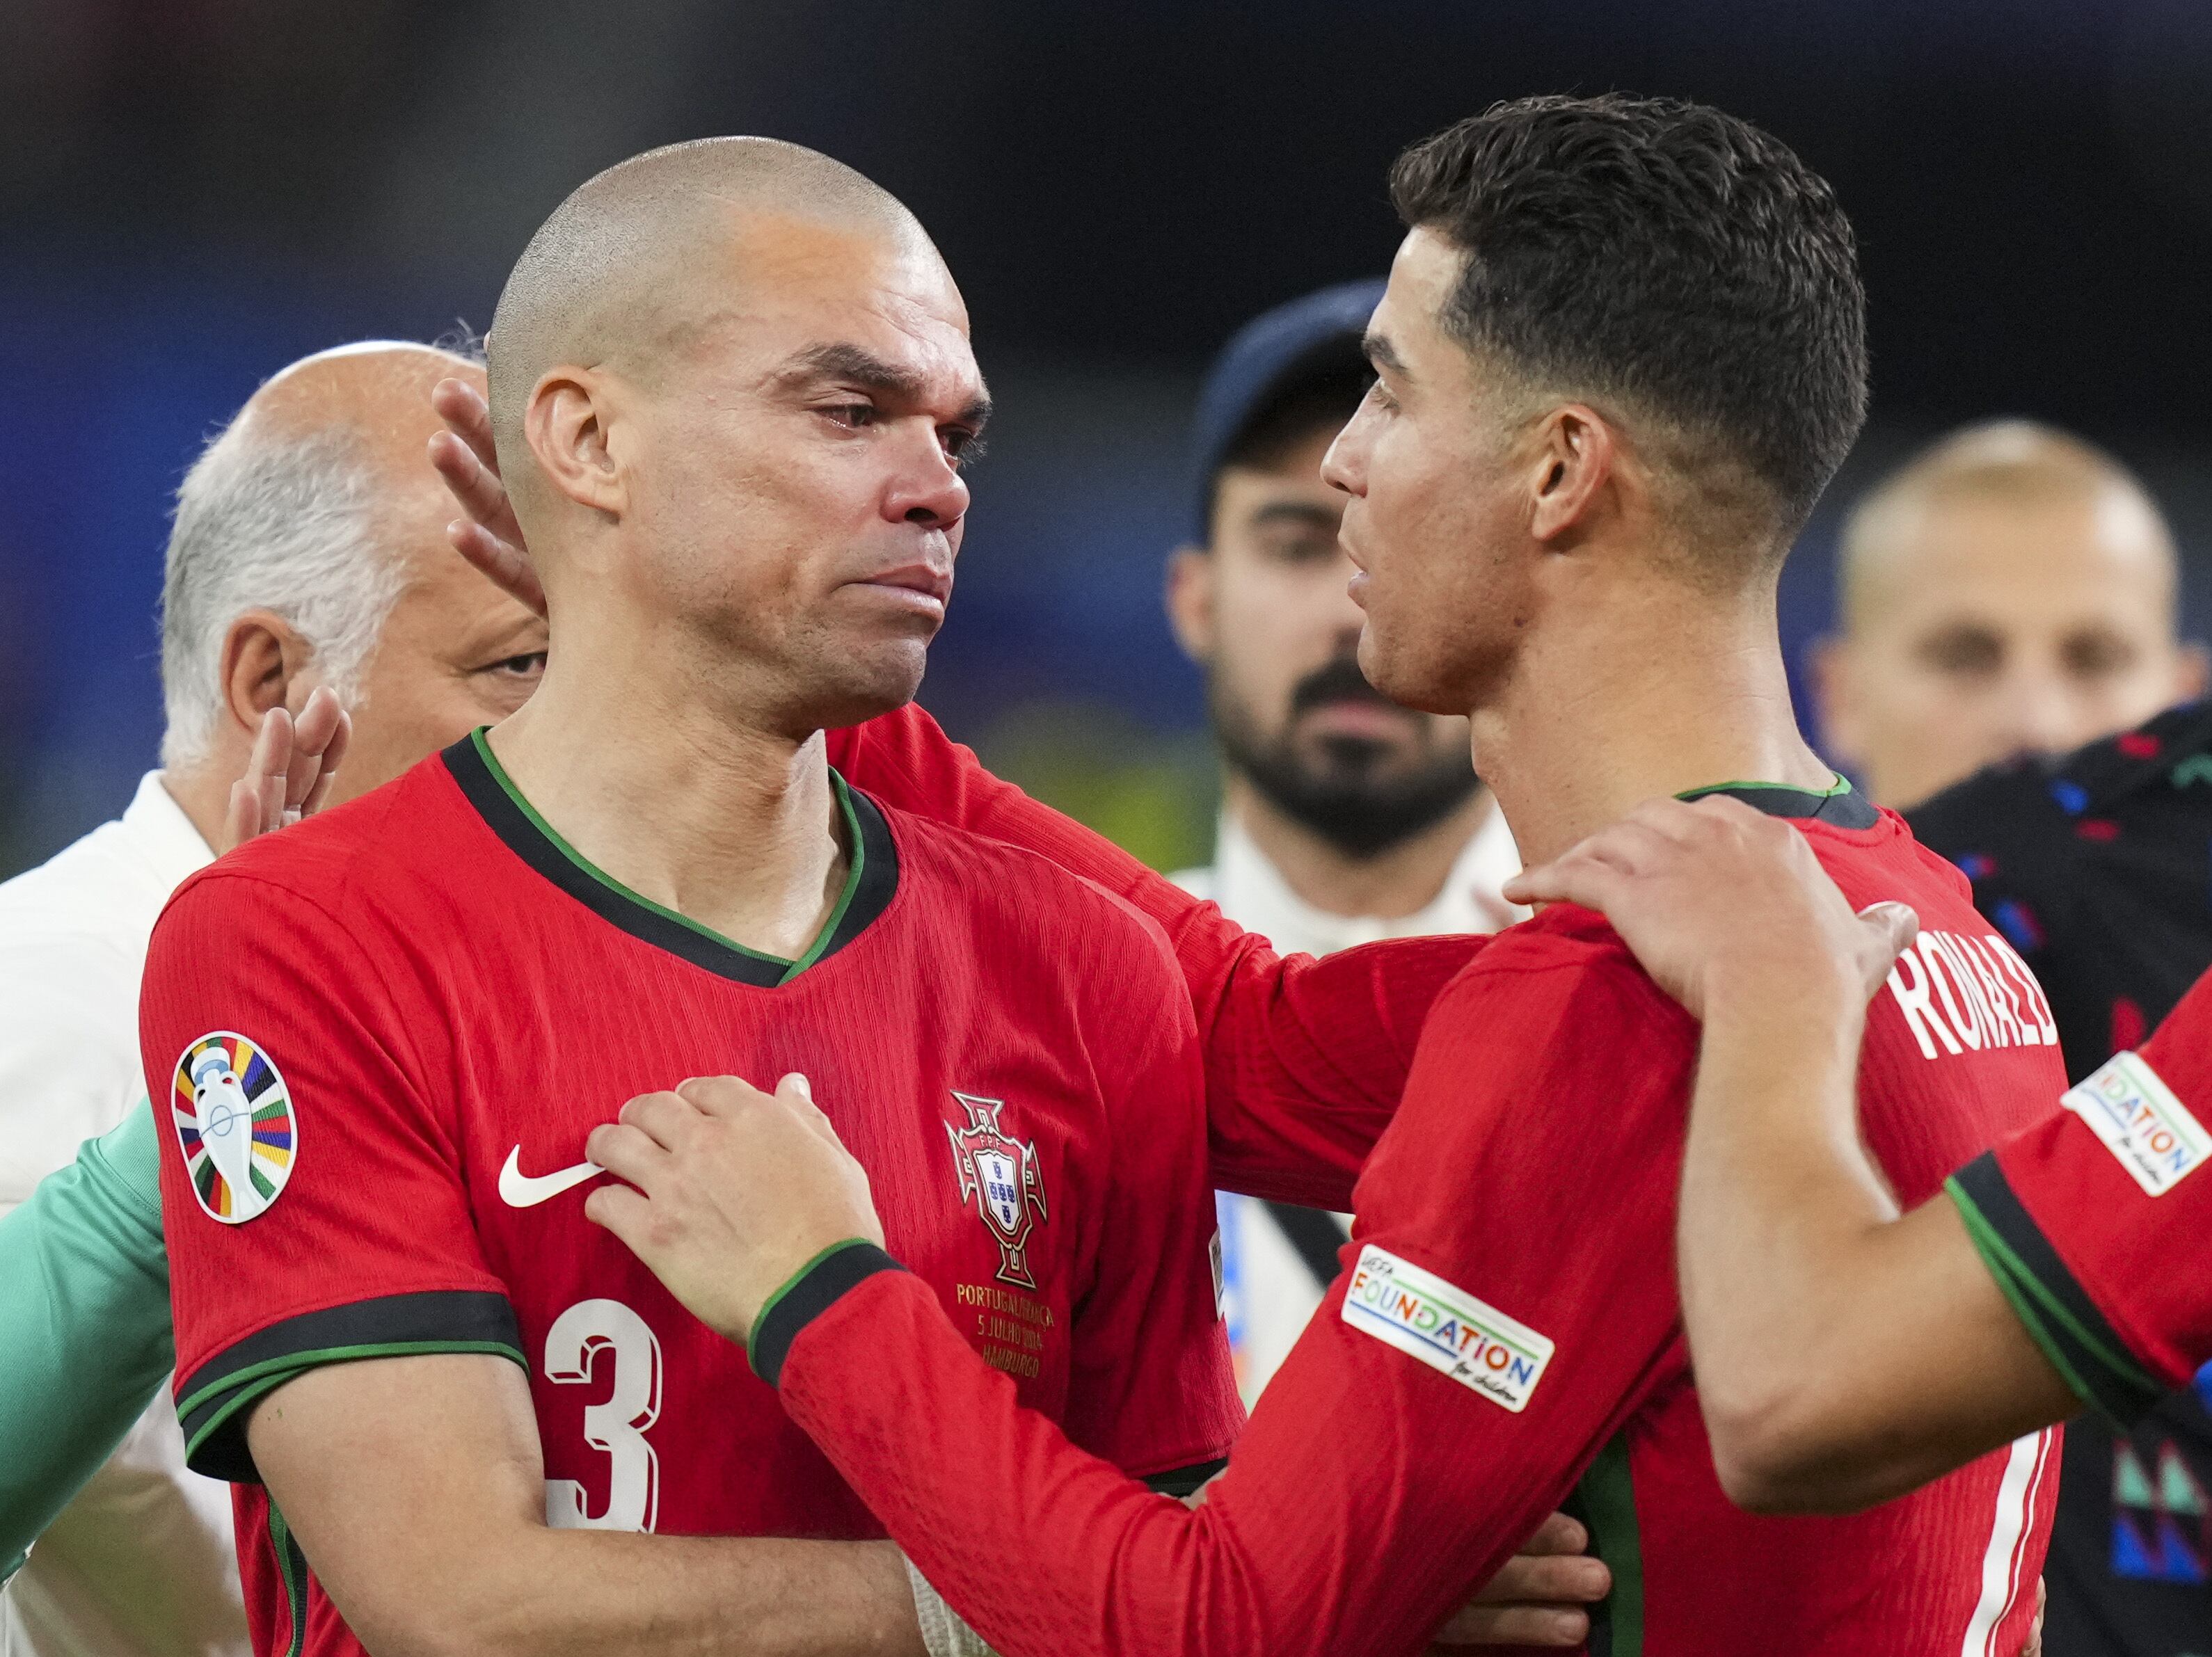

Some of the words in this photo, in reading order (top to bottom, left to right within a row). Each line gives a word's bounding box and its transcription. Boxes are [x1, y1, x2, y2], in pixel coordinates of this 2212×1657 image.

[978, 1314, 985, 1335] 5
[988, 1315, 1021, 1345] JULHO
[983, 1344, 1040, 1378] HAMBURGO
[545, 1298, 662, 1534] 3
